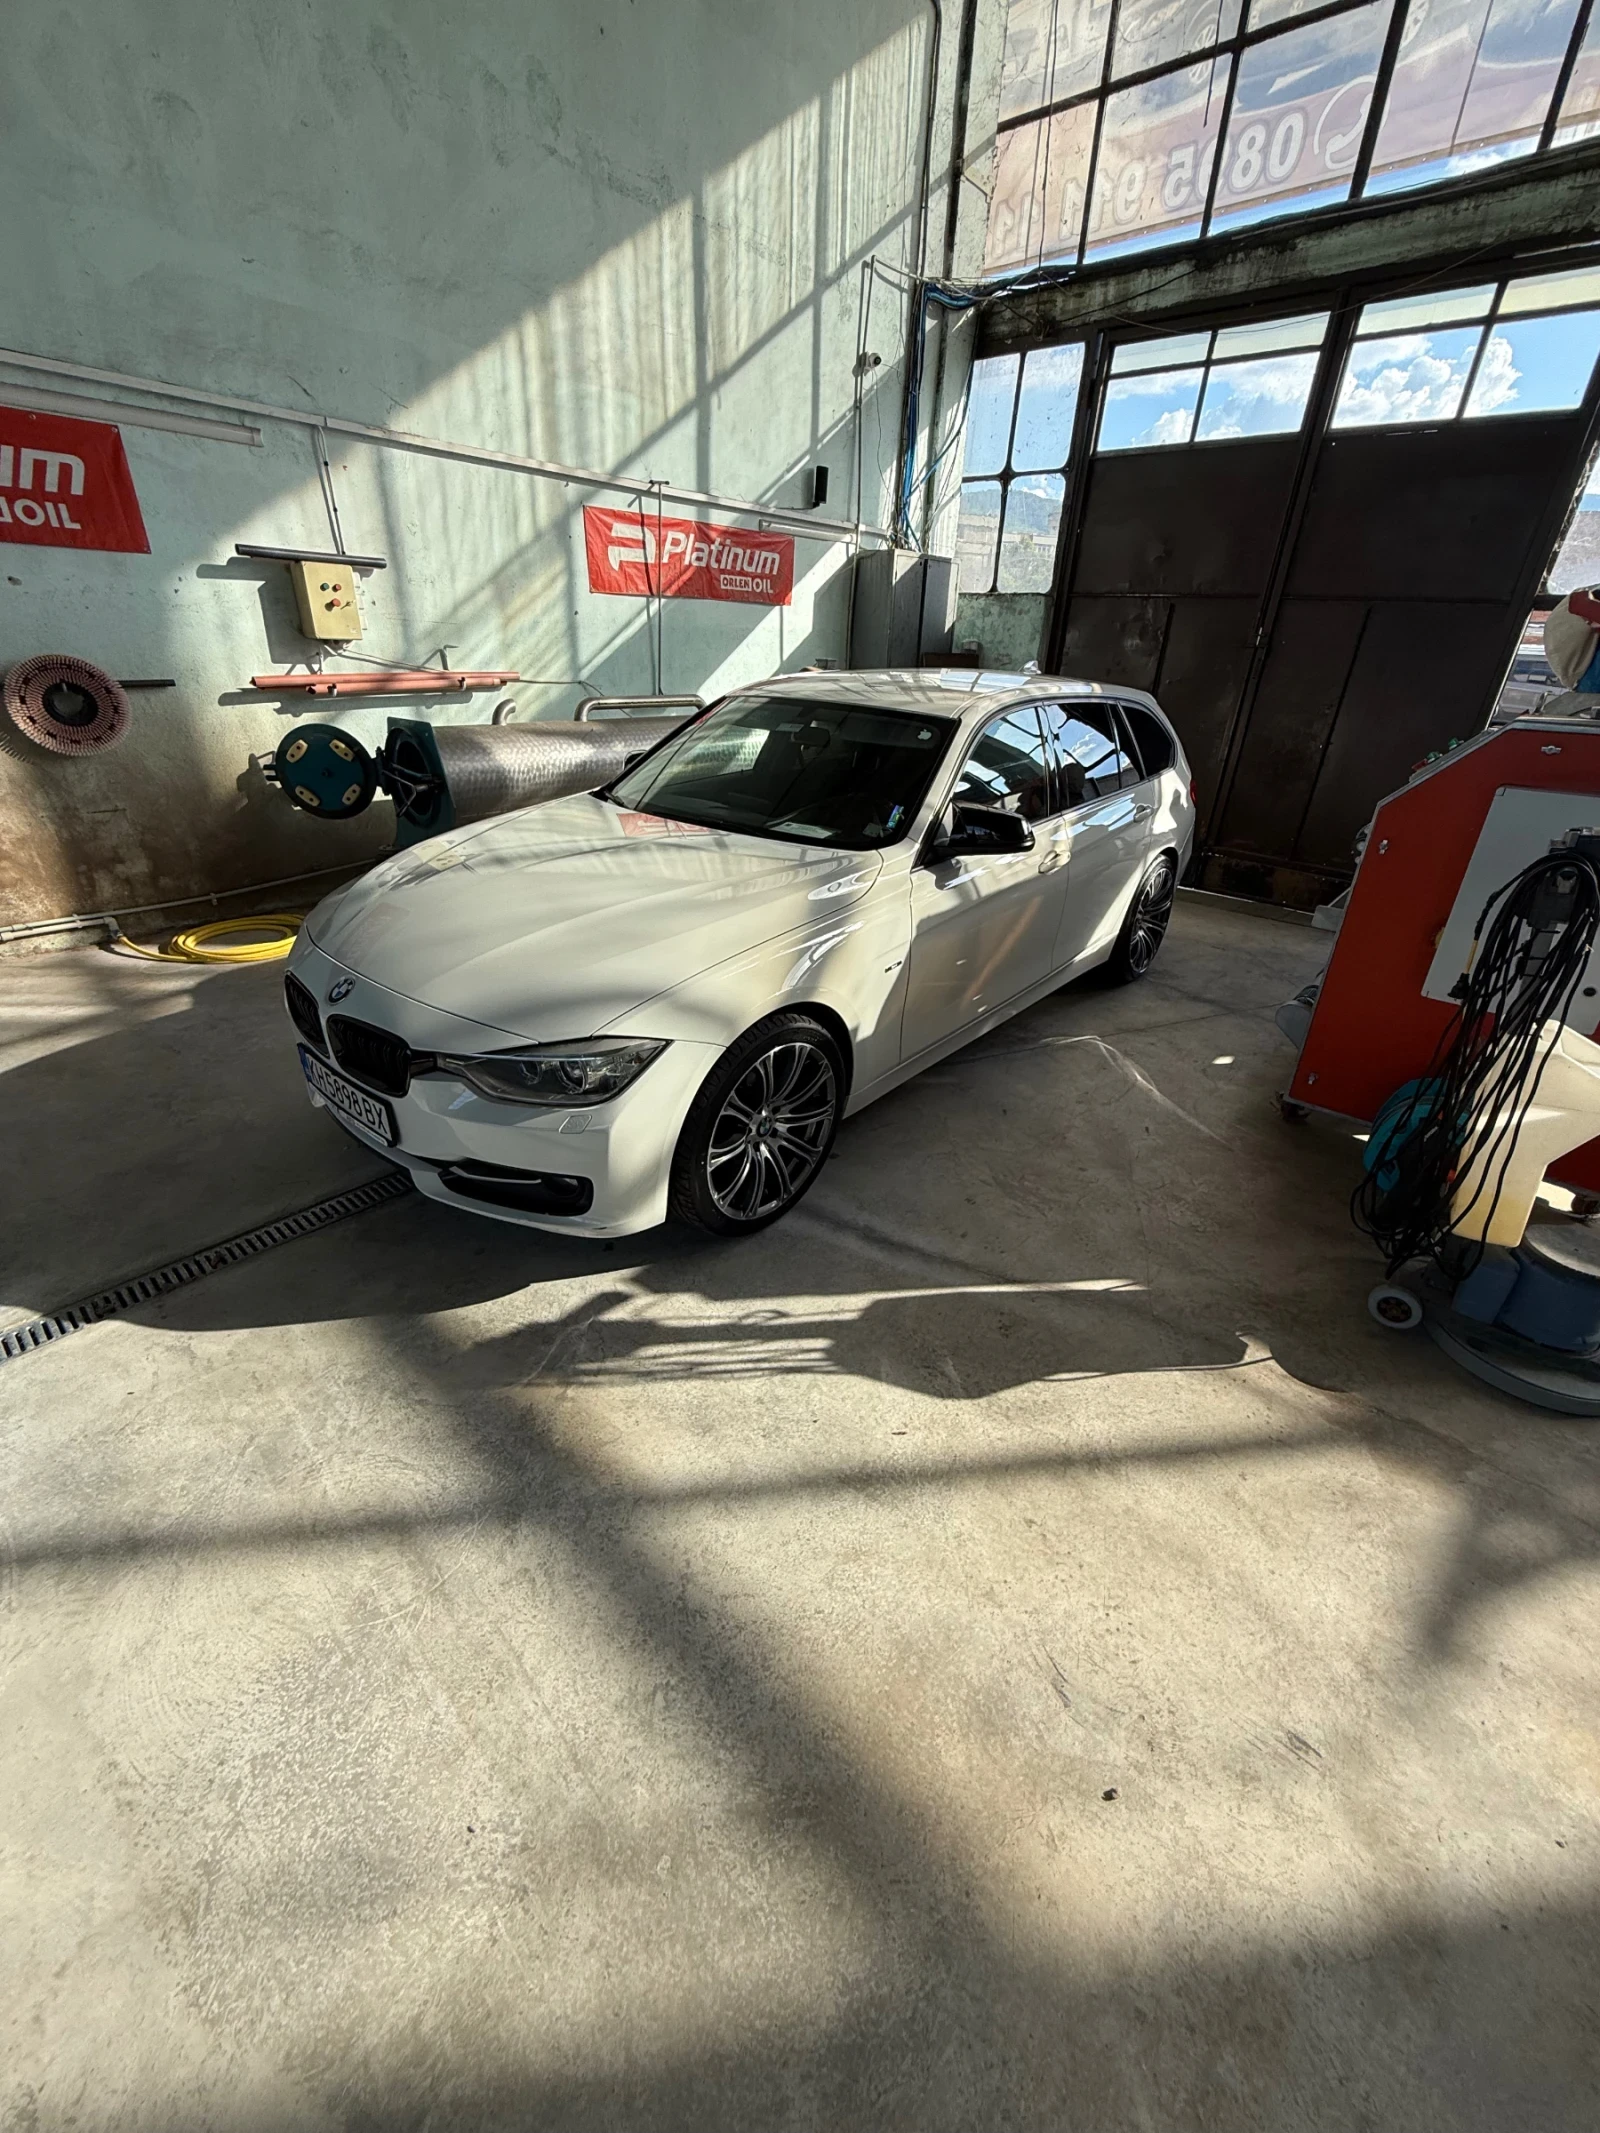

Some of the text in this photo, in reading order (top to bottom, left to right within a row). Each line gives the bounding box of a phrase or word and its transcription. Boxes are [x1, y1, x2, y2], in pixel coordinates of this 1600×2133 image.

[662, 531, 780, 575] Platinum
[721, 576, 774, 593] ORLEN OIL
